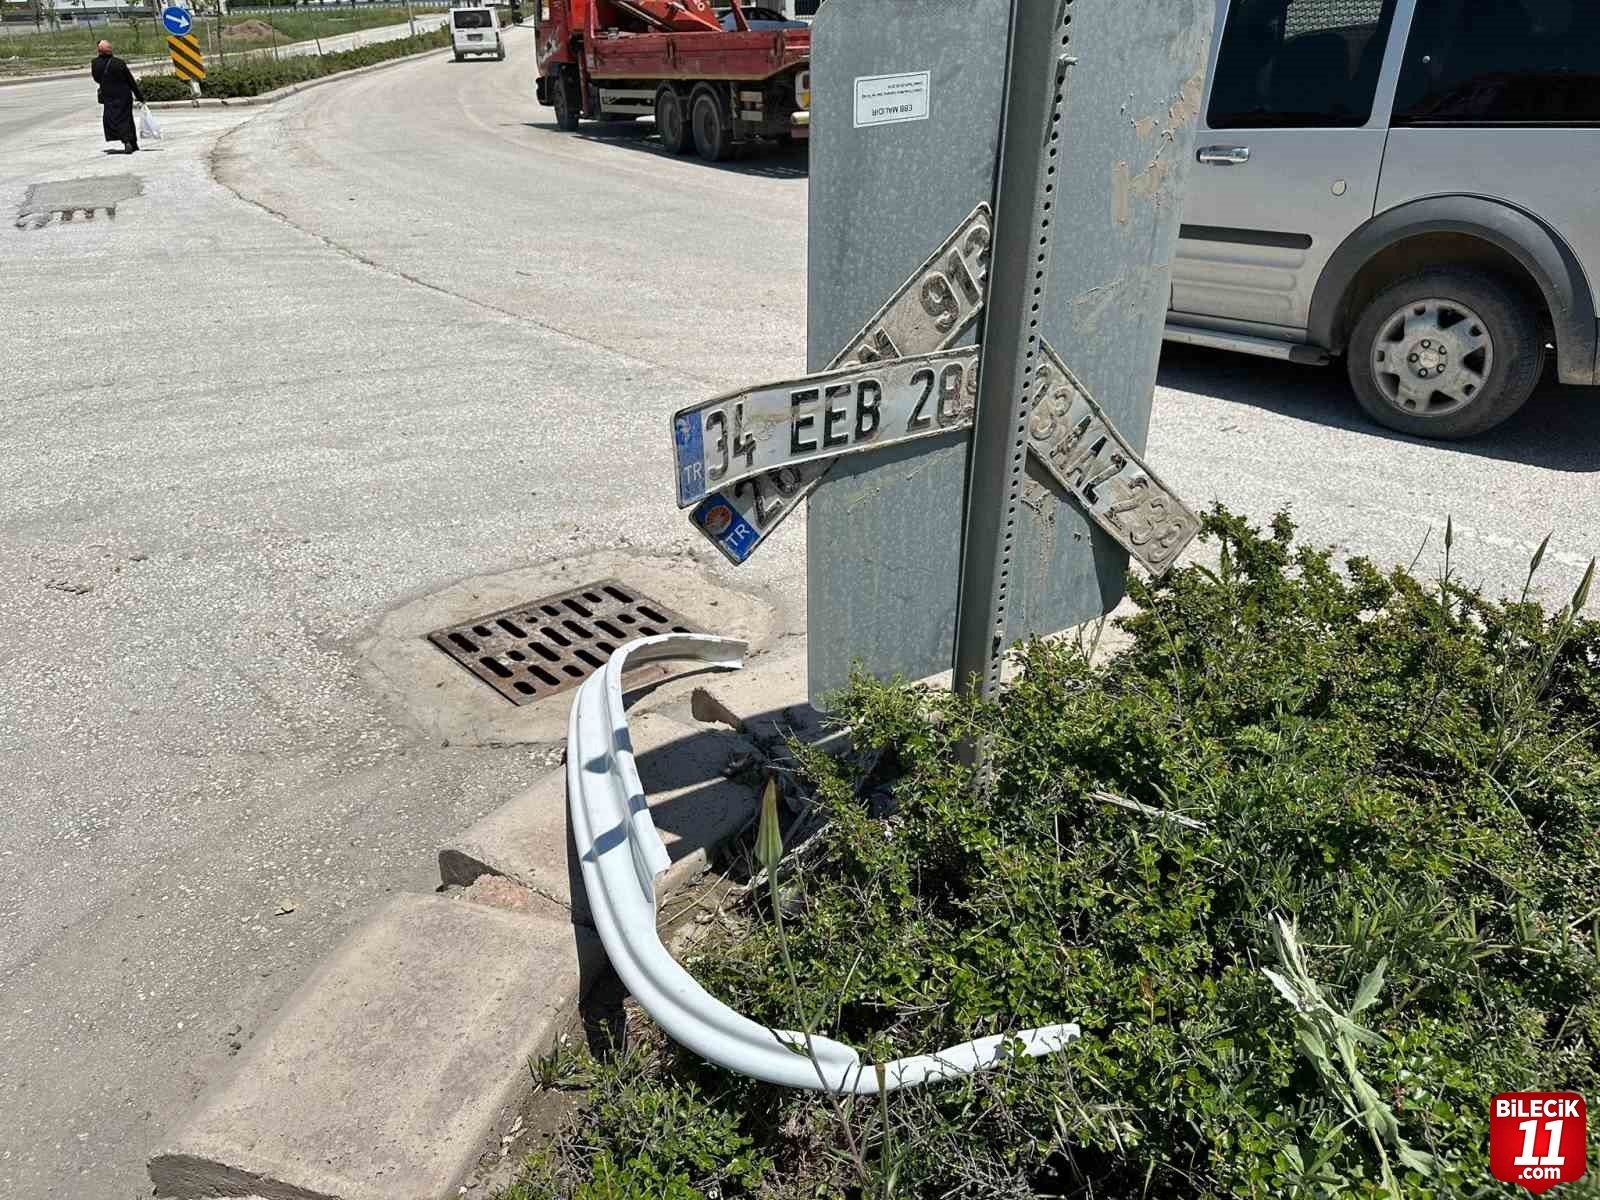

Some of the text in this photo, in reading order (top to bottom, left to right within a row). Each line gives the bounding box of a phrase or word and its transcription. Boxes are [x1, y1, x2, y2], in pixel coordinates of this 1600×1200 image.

[684, 462, 702, 484] TR
[705, 401, 757, 481] 34
[790, 379, 883, 454] EEB
[727, 523, 750, 547] TR
